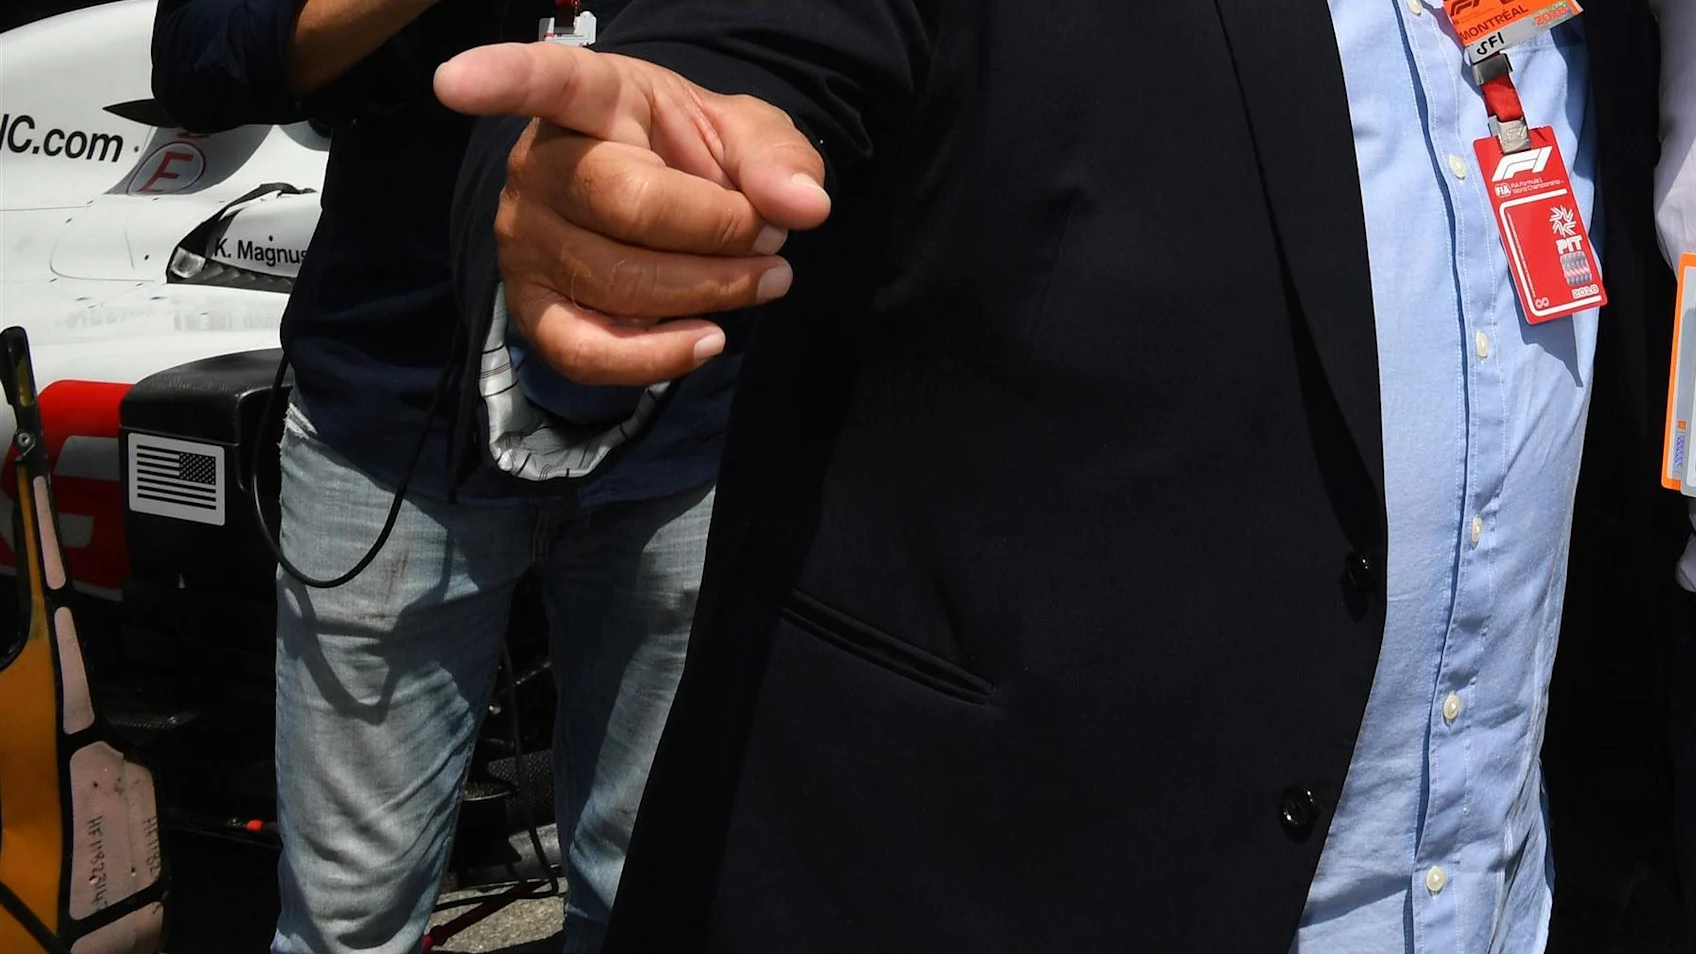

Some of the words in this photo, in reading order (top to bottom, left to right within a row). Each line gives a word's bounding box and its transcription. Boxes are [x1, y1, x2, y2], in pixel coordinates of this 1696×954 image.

[1459, 5, 1529, 42] MONTRÉAL
[1491, 145, 1553, 183] F1
[214, 237, 232, 258] K.
[1555, 235, 1583, 256] PIT
[1570, 284, 1600, 300] 2018
